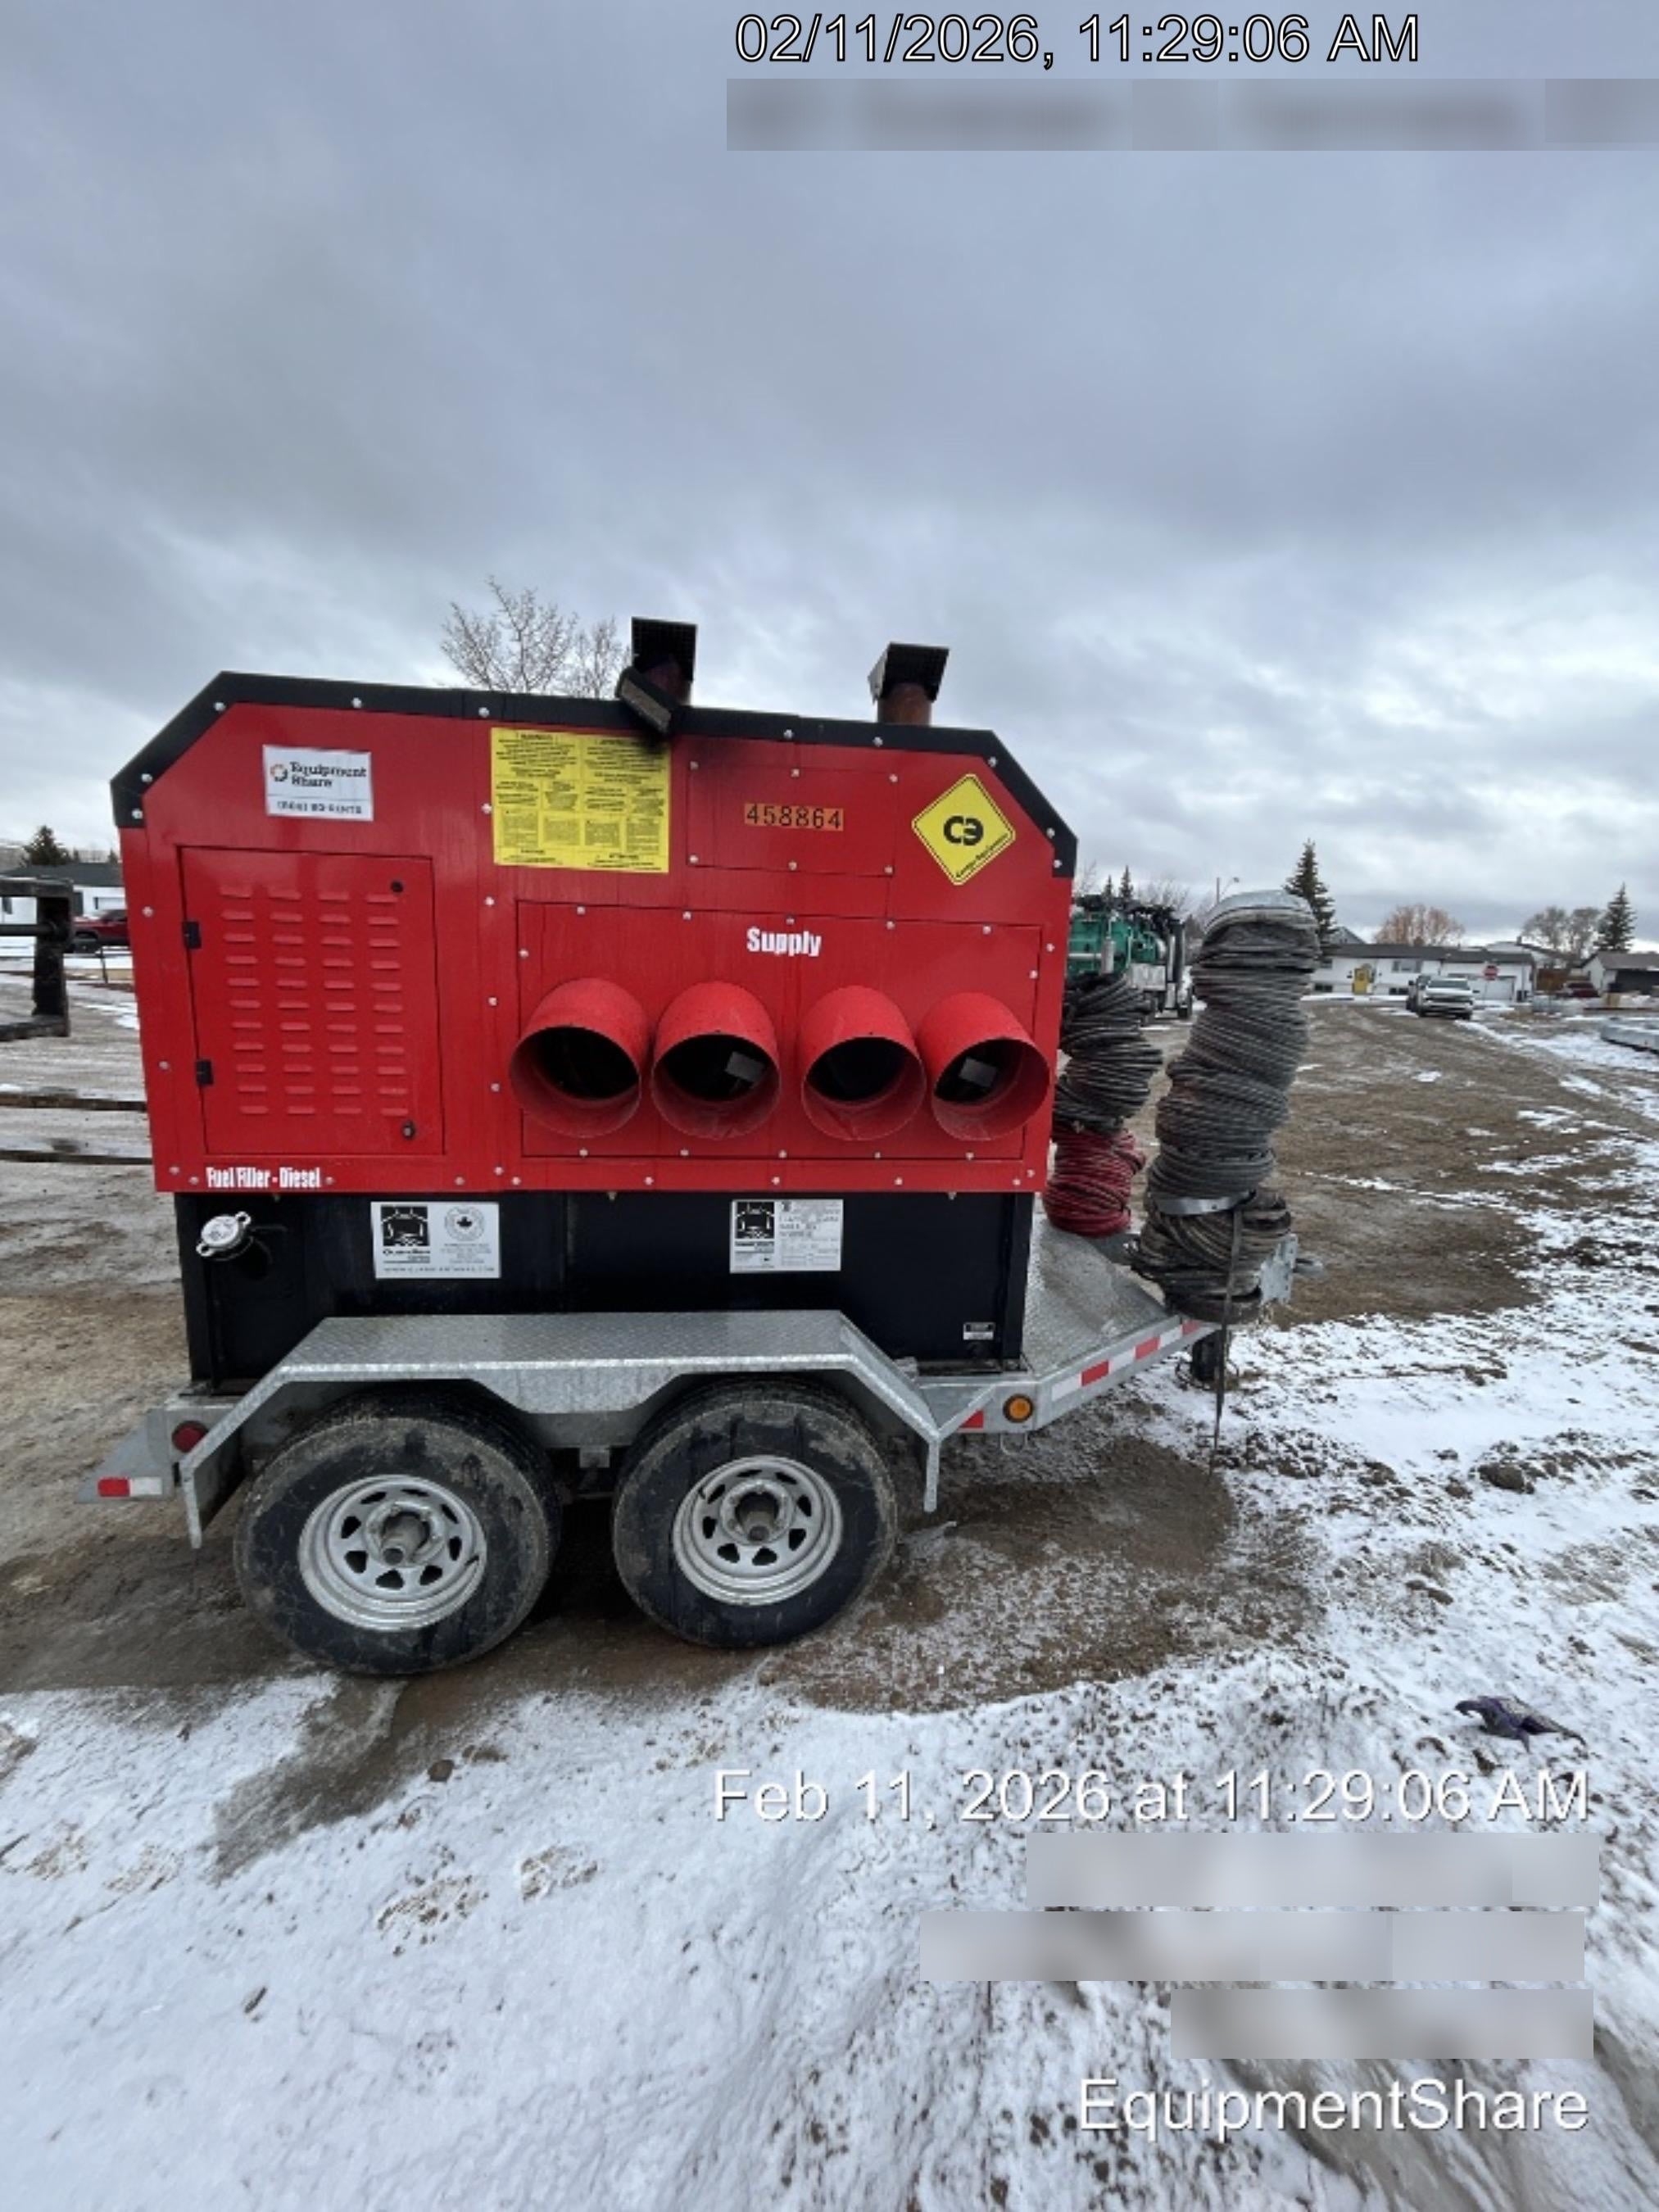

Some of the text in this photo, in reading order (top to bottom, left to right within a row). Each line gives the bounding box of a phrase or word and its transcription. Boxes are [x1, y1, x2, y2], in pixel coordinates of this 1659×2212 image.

[746, 804, 841, 829] 458864
[747, 927, 822, 957] Supply
[206, 1167, 234, 1188] Fuel
[279, 1167, 320, 1188] Diesel
